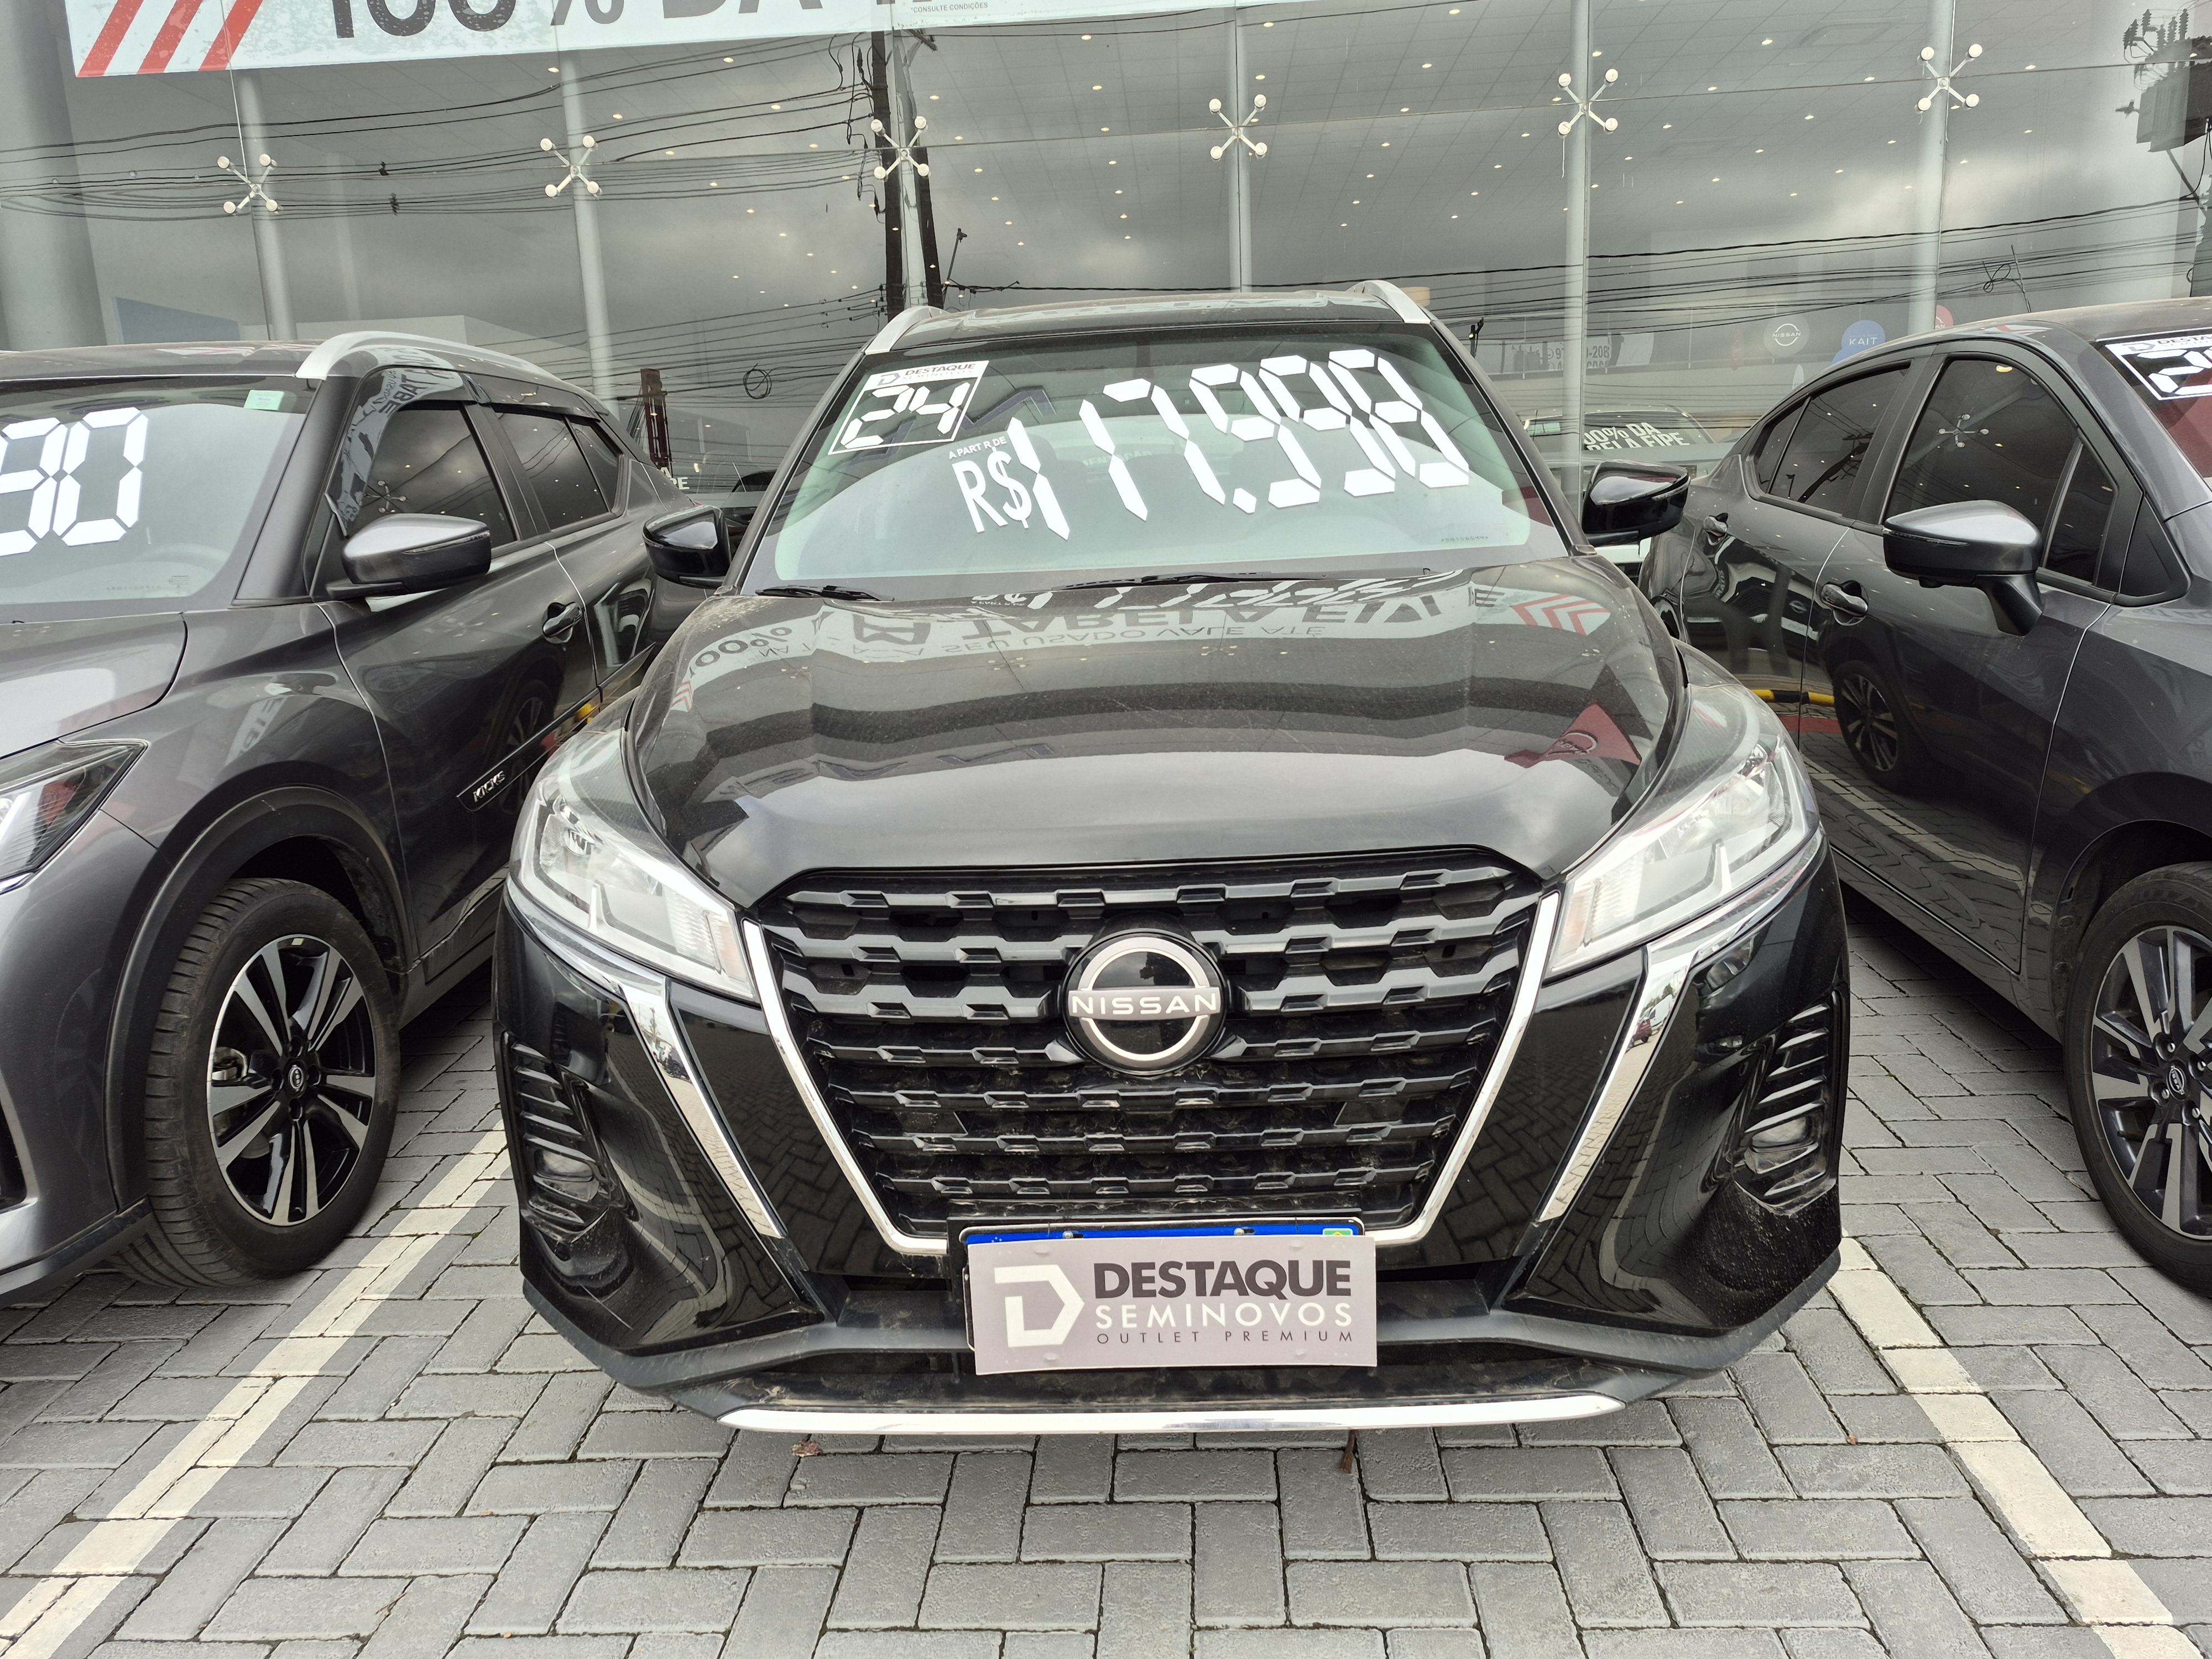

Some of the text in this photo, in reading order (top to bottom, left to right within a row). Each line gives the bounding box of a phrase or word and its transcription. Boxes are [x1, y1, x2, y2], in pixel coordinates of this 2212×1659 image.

[950, 2, 988, 11] CONDIÇÕES
[1849, 337, 1878, 346] KAIT
[905, 363, 976, 376] DESTAQUE
[2137, 346, 2212, 395] 2
[840, 382, 971, 450] 24
[1625, 422, 1662, 437] DA
[948, 451, 957, 460] A
[992, 436, 1007, 447] DE
[473, 770, 506, 802] KICKS
[1072, 993, 1218, 1015] NISSAN
[1093, 1259, 1352, 1300] DESTAQUE
[1095, 1301, 1353, 1329] SEMINOVOS
[1097, 1329, 1353, 1344] OUTLET PREMIUM
